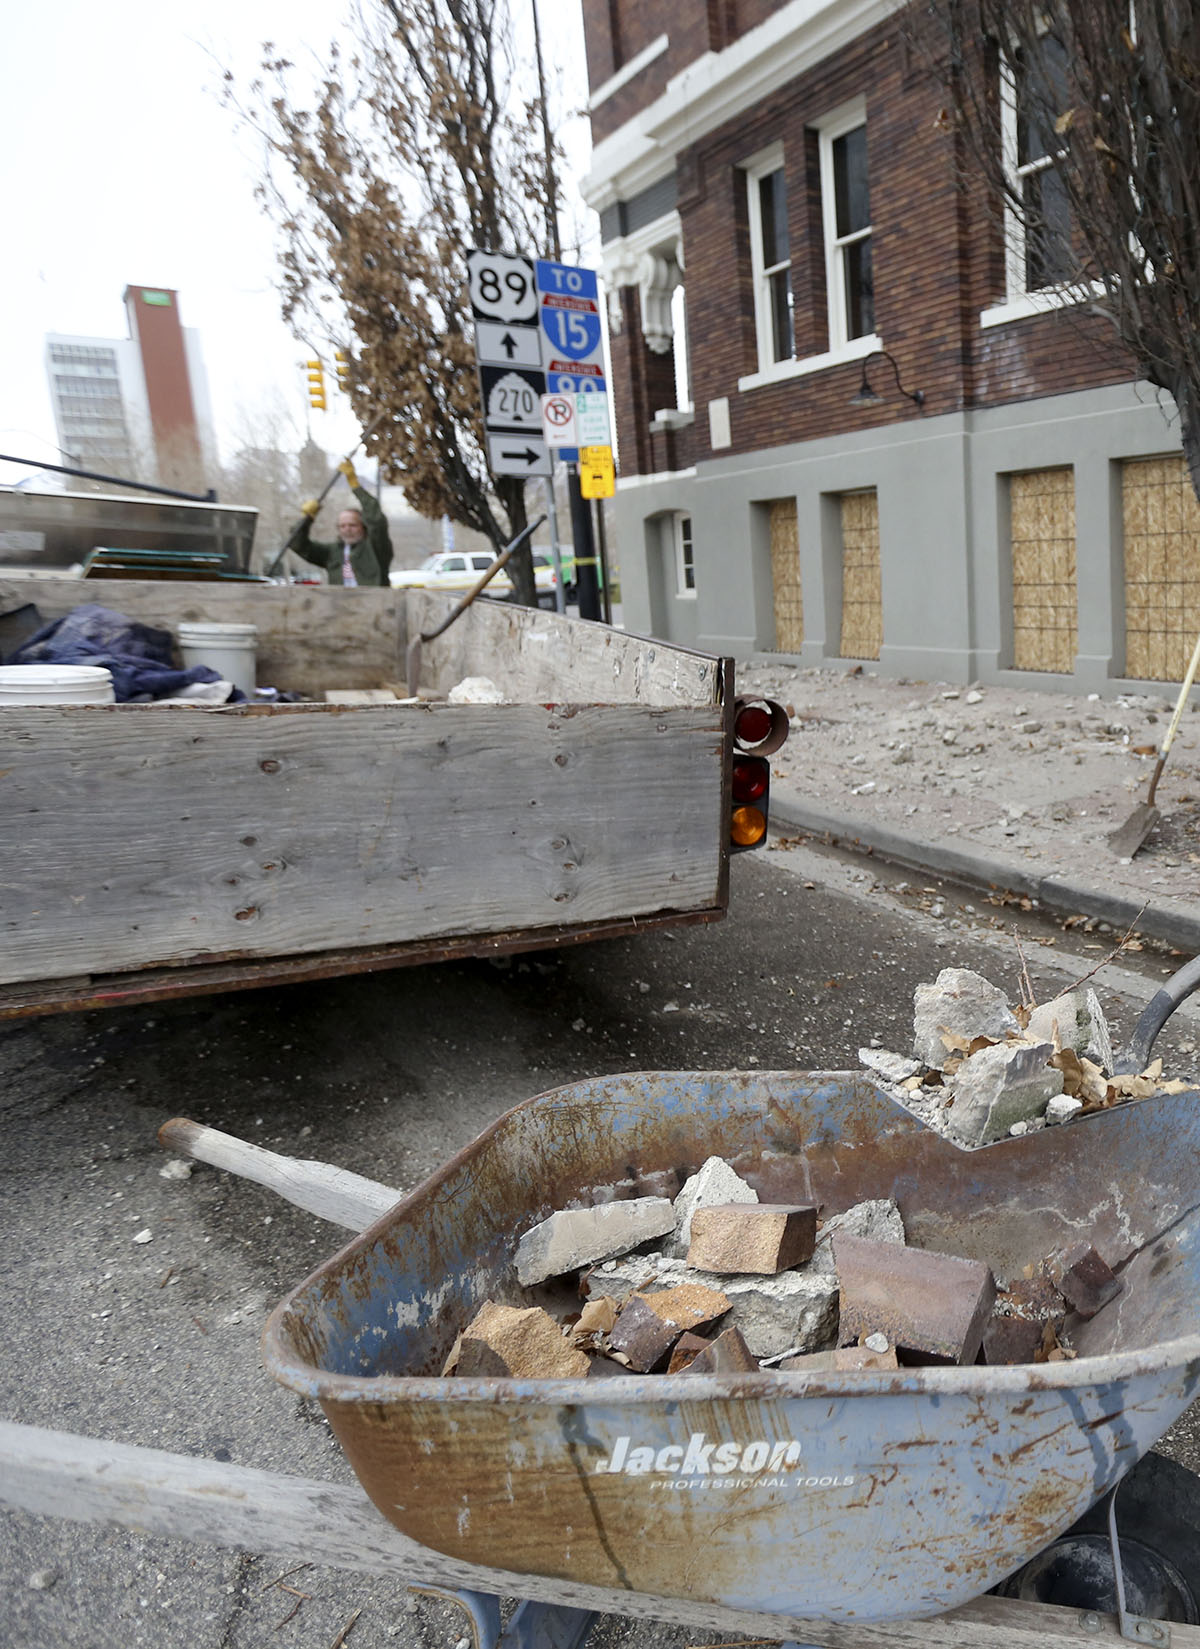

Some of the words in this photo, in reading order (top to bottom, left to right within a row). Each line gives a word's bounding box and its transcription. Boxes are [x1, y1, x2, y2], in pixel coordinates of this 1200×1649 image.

[479, 268, 527, 305] 89
[551, 268, 584, 292] TO
[556, 310, 589, 350] 15
[498, 387, 534, 414] 270
[595, 1432, 802, 1476] Jackson
[650, 1477, 789, 1491] PROFESSIONAL
[795, 1475, 855, 1488] TOOLS
